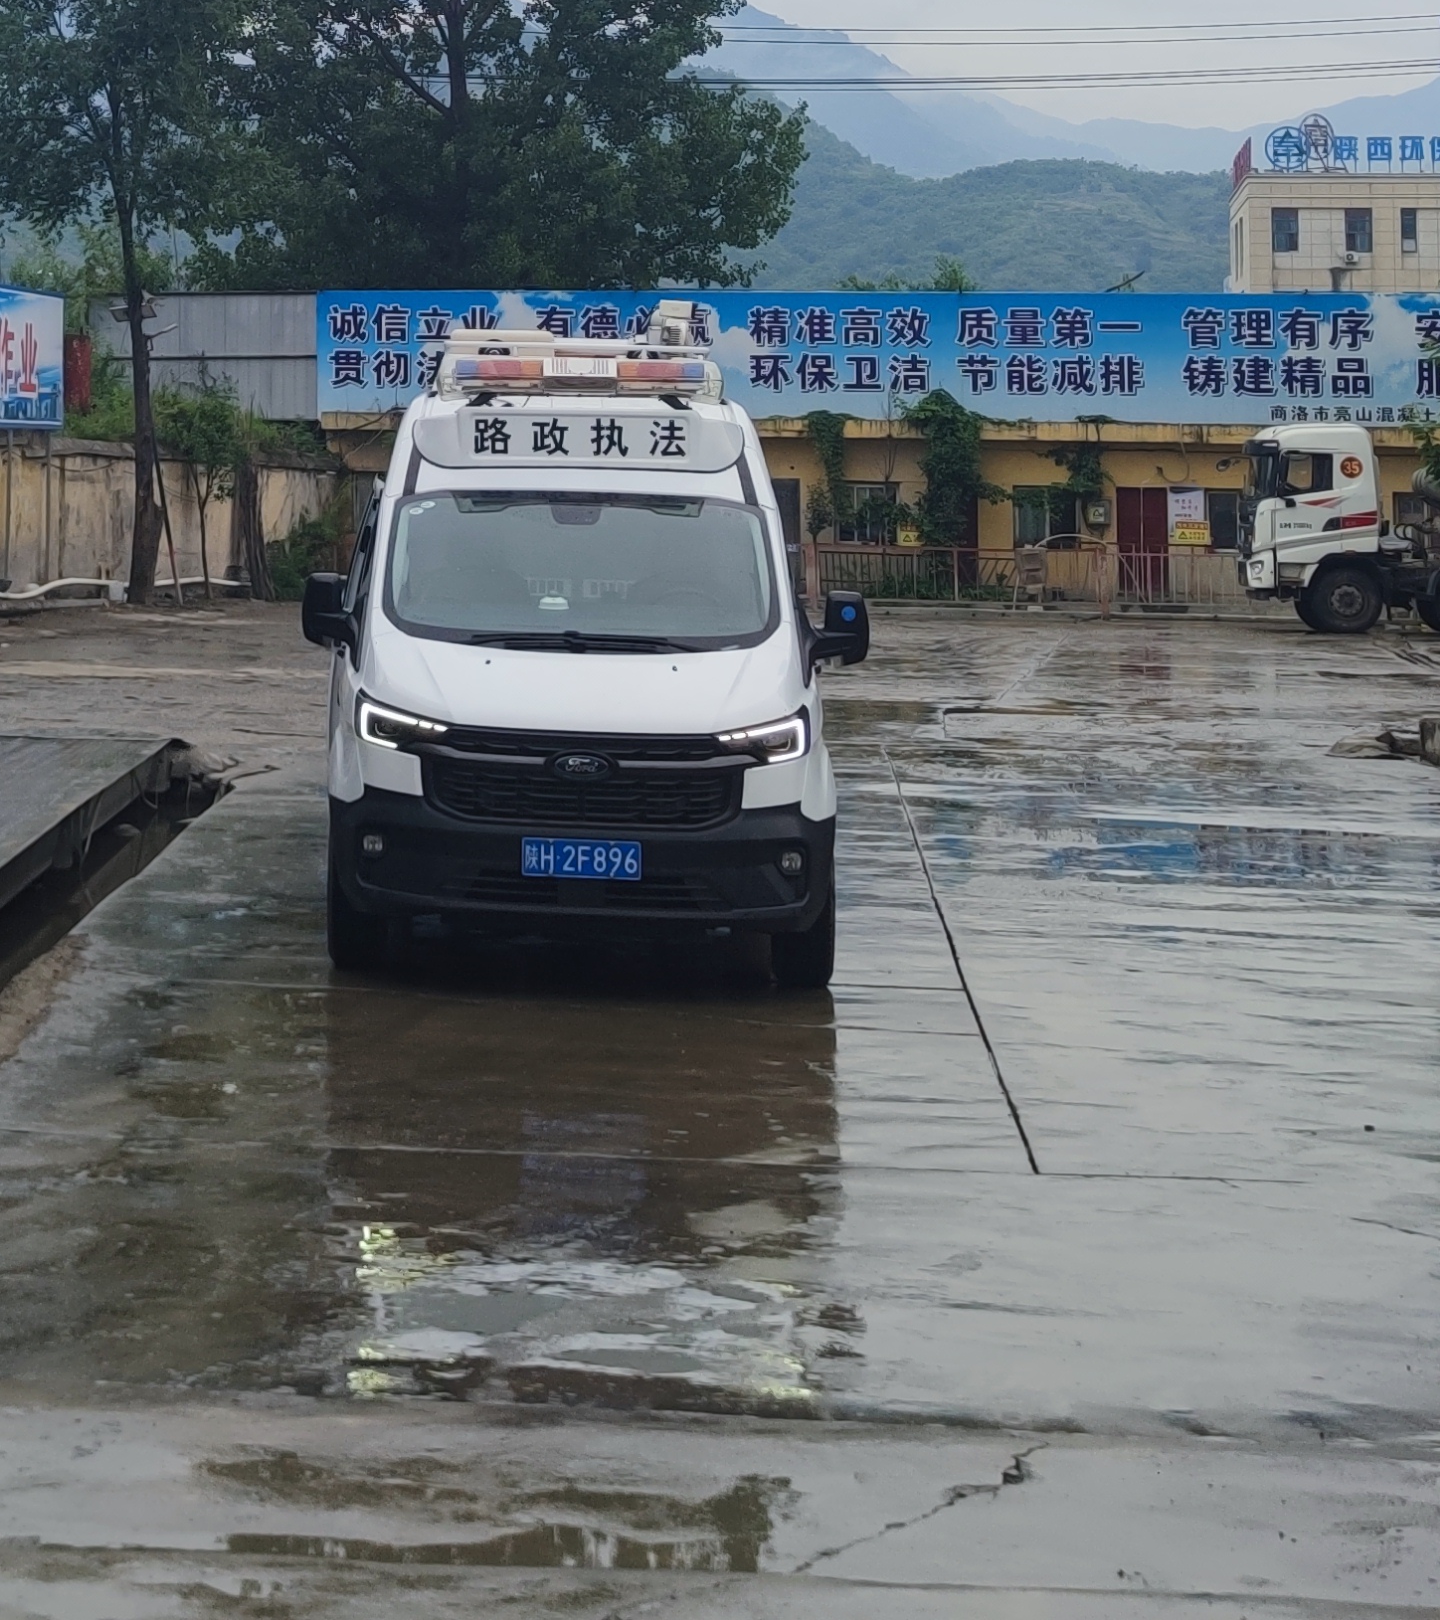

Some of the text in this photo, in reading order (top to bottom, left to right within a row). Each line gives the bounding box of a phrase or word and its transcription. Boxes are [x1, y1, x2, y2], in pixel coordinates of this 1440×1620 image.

[327, 304, 499, 344] 诚信立业
[748, 306, 932, 347] 精准高效
[955, 306, 1143, 348] 质量第一
[1182, 306, 1373, 350] 管理有序
[749, 352, 931, 393] 环保卫洁
[956, 353, 1144, 395] 节能减排
[1182, 354, 1374, 398] 铸建精品
[474, 417, 686, 457] 路政执法
[1343, 462, 1360, 474] 35
[565, 757, 599, 772] Ford
